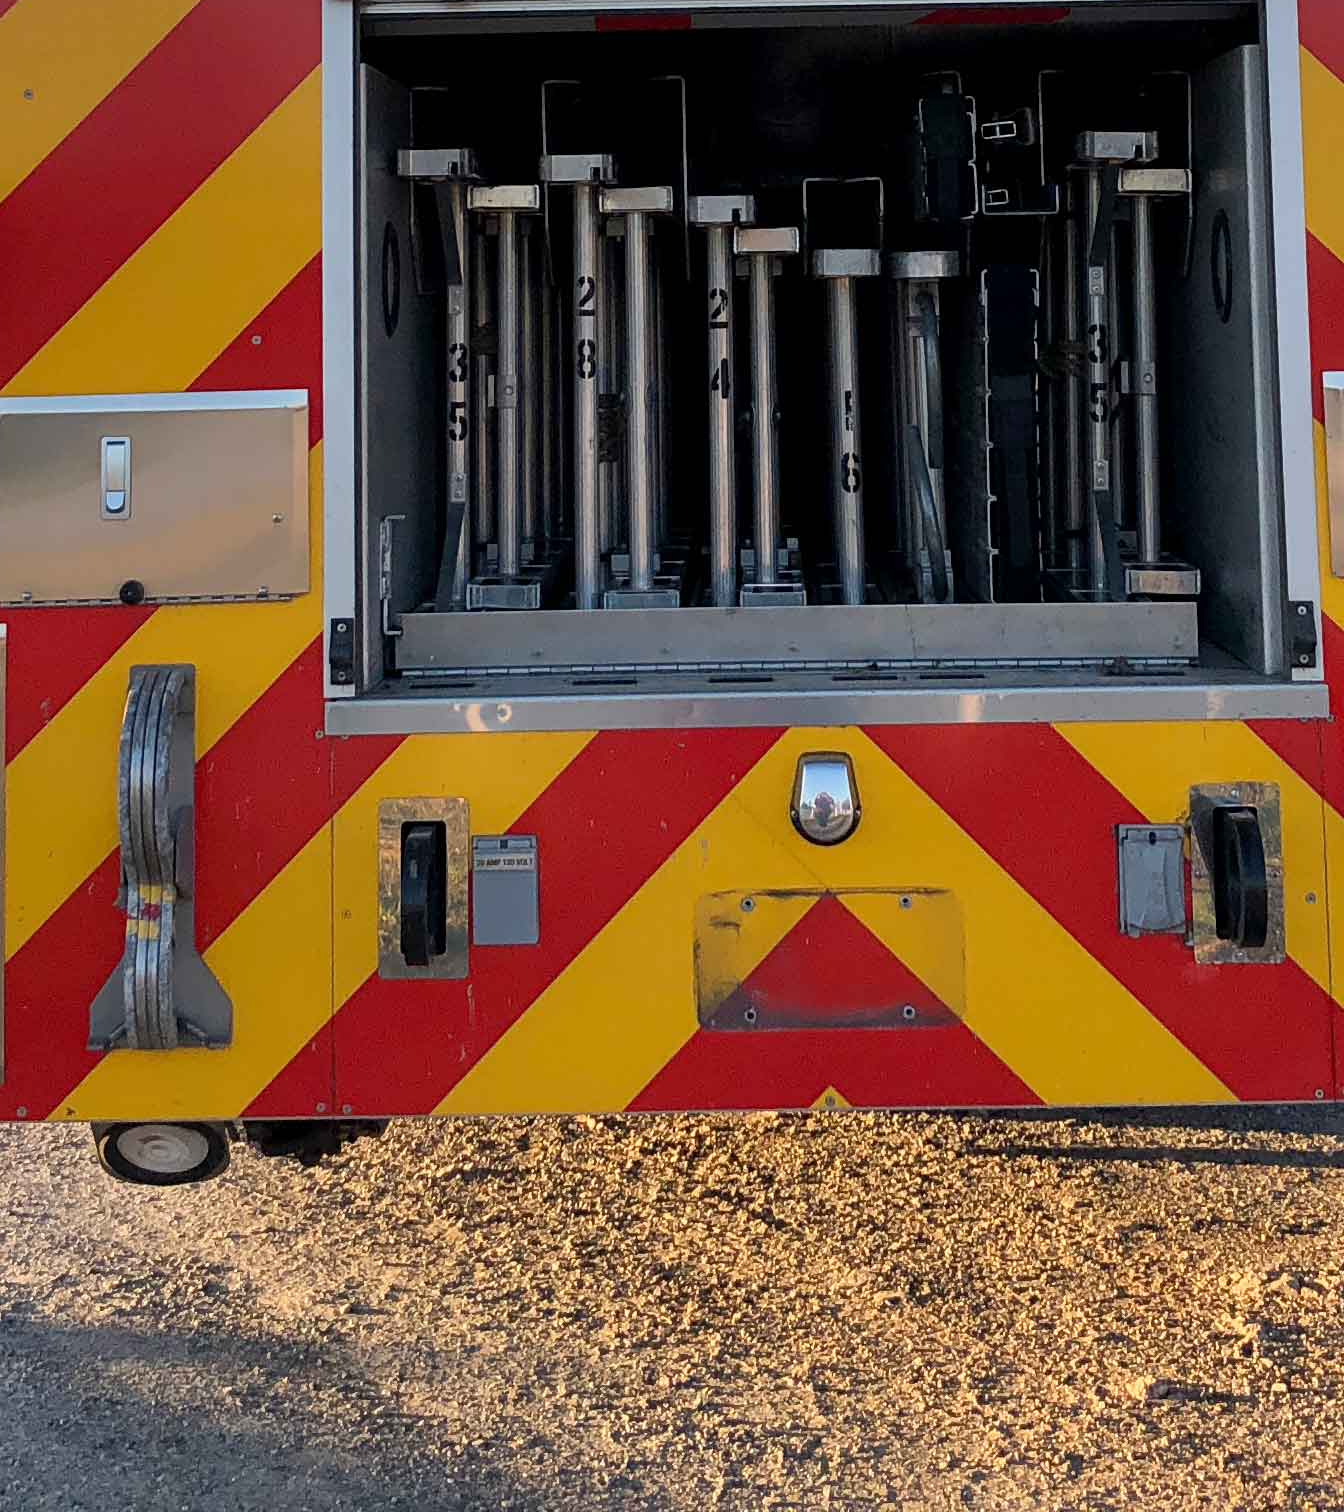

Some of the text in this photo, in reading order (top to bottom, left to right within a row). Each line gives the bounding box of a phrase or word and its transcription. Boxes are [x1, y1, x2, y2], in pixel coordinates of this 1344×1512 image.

[577, 276, 596, 379] 28
[709, 288, 729, 399] 24
[449, 343, 467, 441] 35
